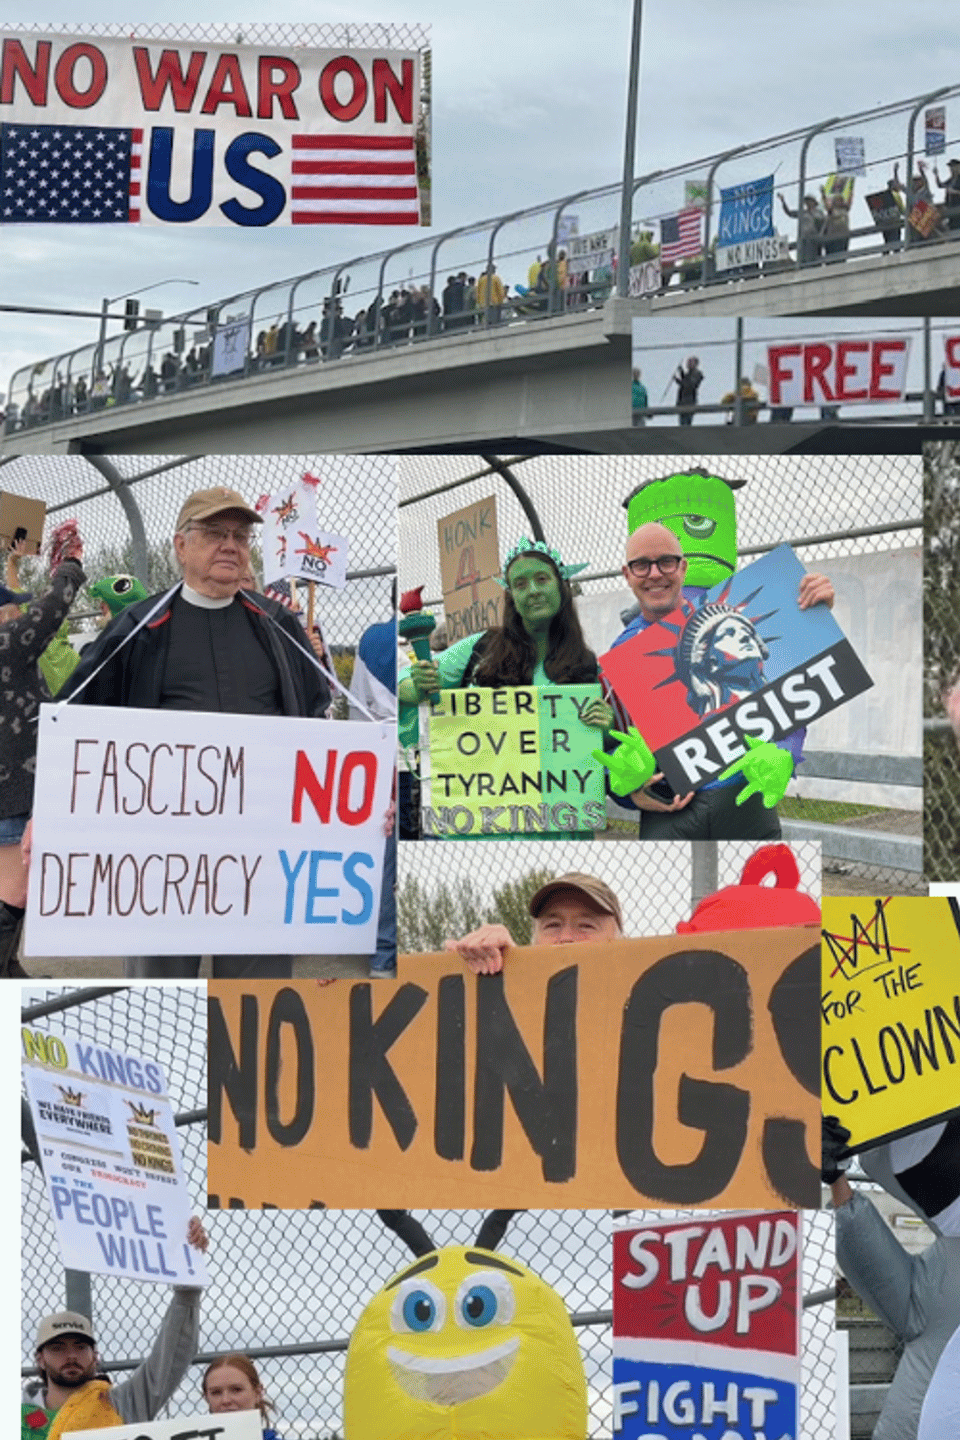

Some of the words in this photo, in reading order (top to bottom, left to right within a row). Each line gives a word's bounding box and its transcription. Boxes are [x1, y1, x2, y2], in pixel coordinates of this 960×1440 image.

[2, 38, 109, 109] NO
[133, 46, 301, 122] WAR
[318, 55, 415, 125] ON
[146, 127, 288, 227] US
[721, 203, 771, 239] KINGS
[766, 340, 908, 405] FREE
[444, 508, 492, 554] HONK
[302, 555, 326, 571] NO
[455, 545, 481, 602] 4
[430, 690, 590, 719] LIBERTY
[673, 654, 850, 786] RESIST
[456, 729, 572, 756] OVER
[69, 739, 246, 818] FASCISM
[290, 748, 379, 827] NO
[437, 769, 594, 799] TYRANNY
[422, 804, 477, 836] NO
[480, 802, 607, 834] KINGS
[38, 852, 263, 918] DEMOCRACY
[277, 848, 376, 927] YES
[873, 962, 925, 999] THE
[22, 1026, 69, 1071] NO
[76, 1042, 163, 1095] KINGS
[206, 987, 316, 1151] NO
[39, 1108, 113, 1136] EVERYWHERE
[51, 1184, 167, 1240] PEOPLE
[620, 1219, 798, 1290] STAND
[684, 1274, 783, 1335] UP
[612, 1379, 779, 1432] FIGHT
